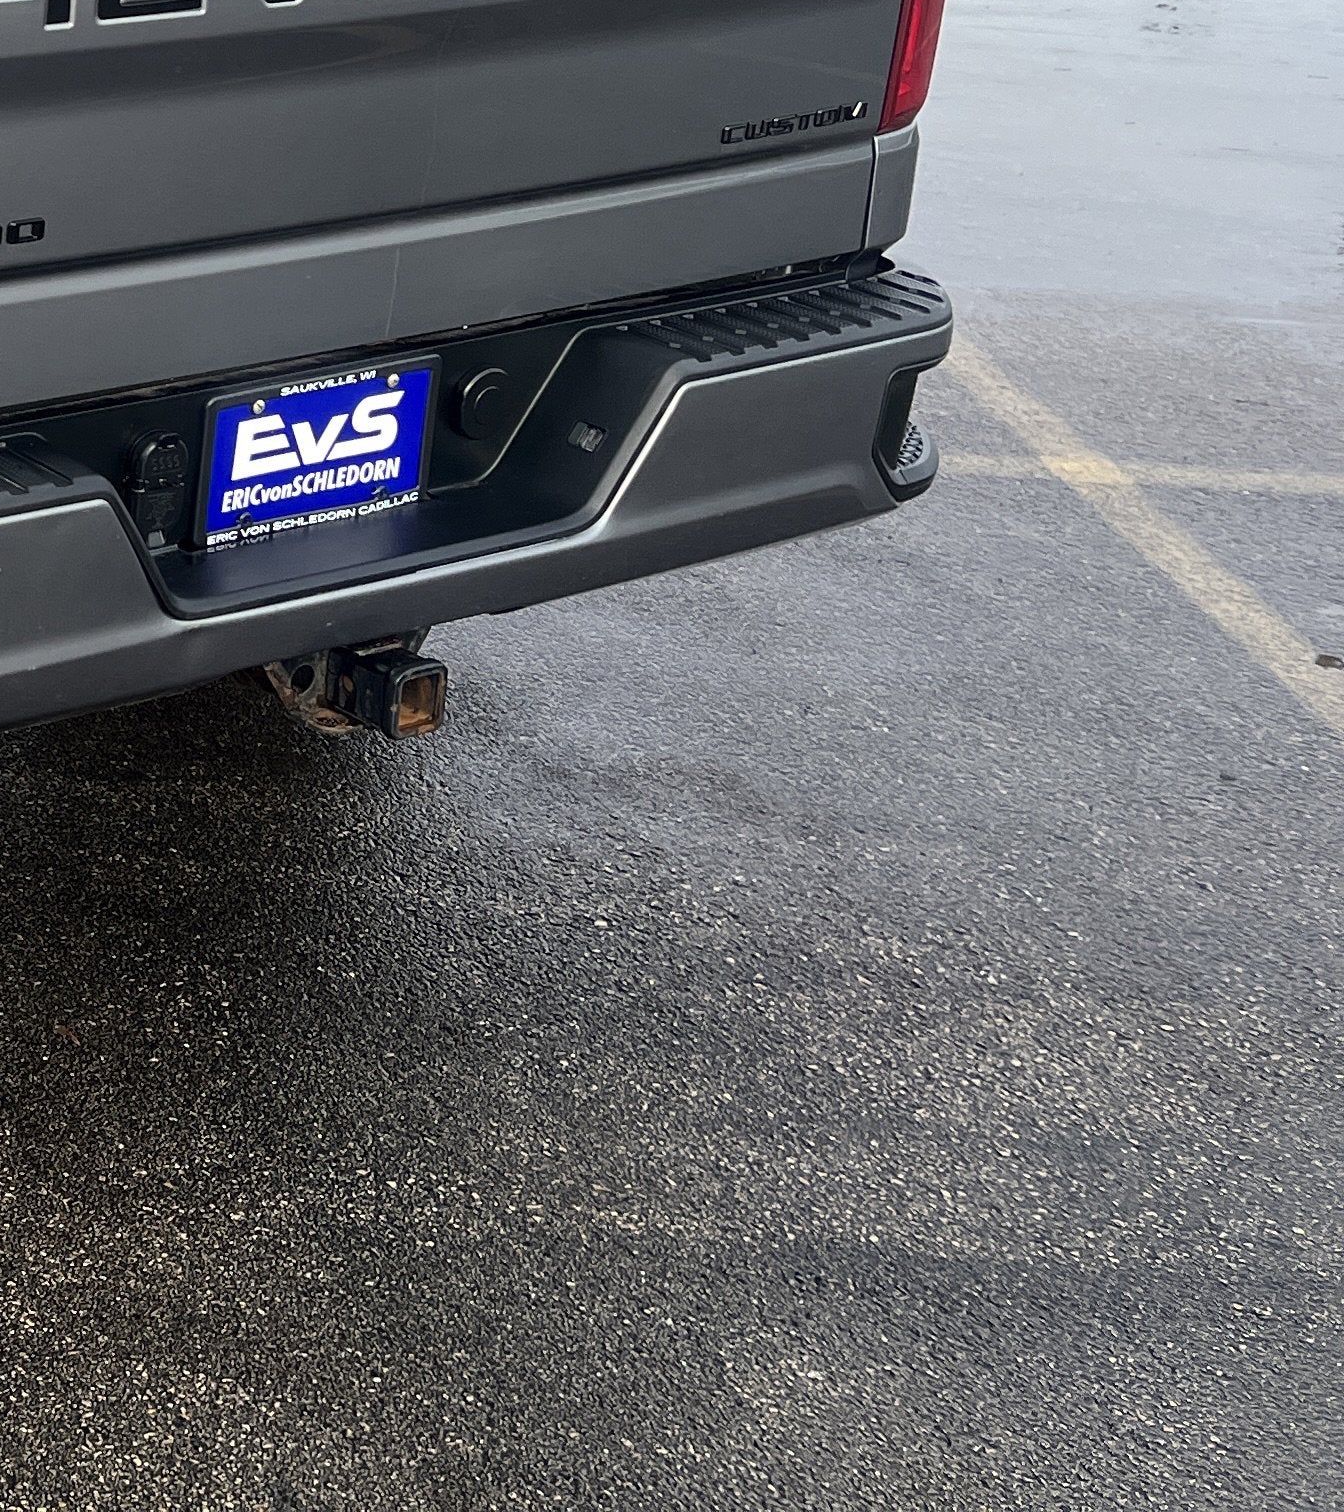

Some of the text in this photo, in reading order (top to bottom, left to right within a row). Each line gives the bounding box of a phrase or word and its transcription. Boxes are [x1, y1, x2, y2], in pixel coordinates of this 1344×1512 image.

[720, 100, 869, 145] CUSTOM
[280, 369, 377, 397] SAUKVILLE, WI
[206, 491, 420, 546] ERIC VON SCHLEDORN CADILLAC
